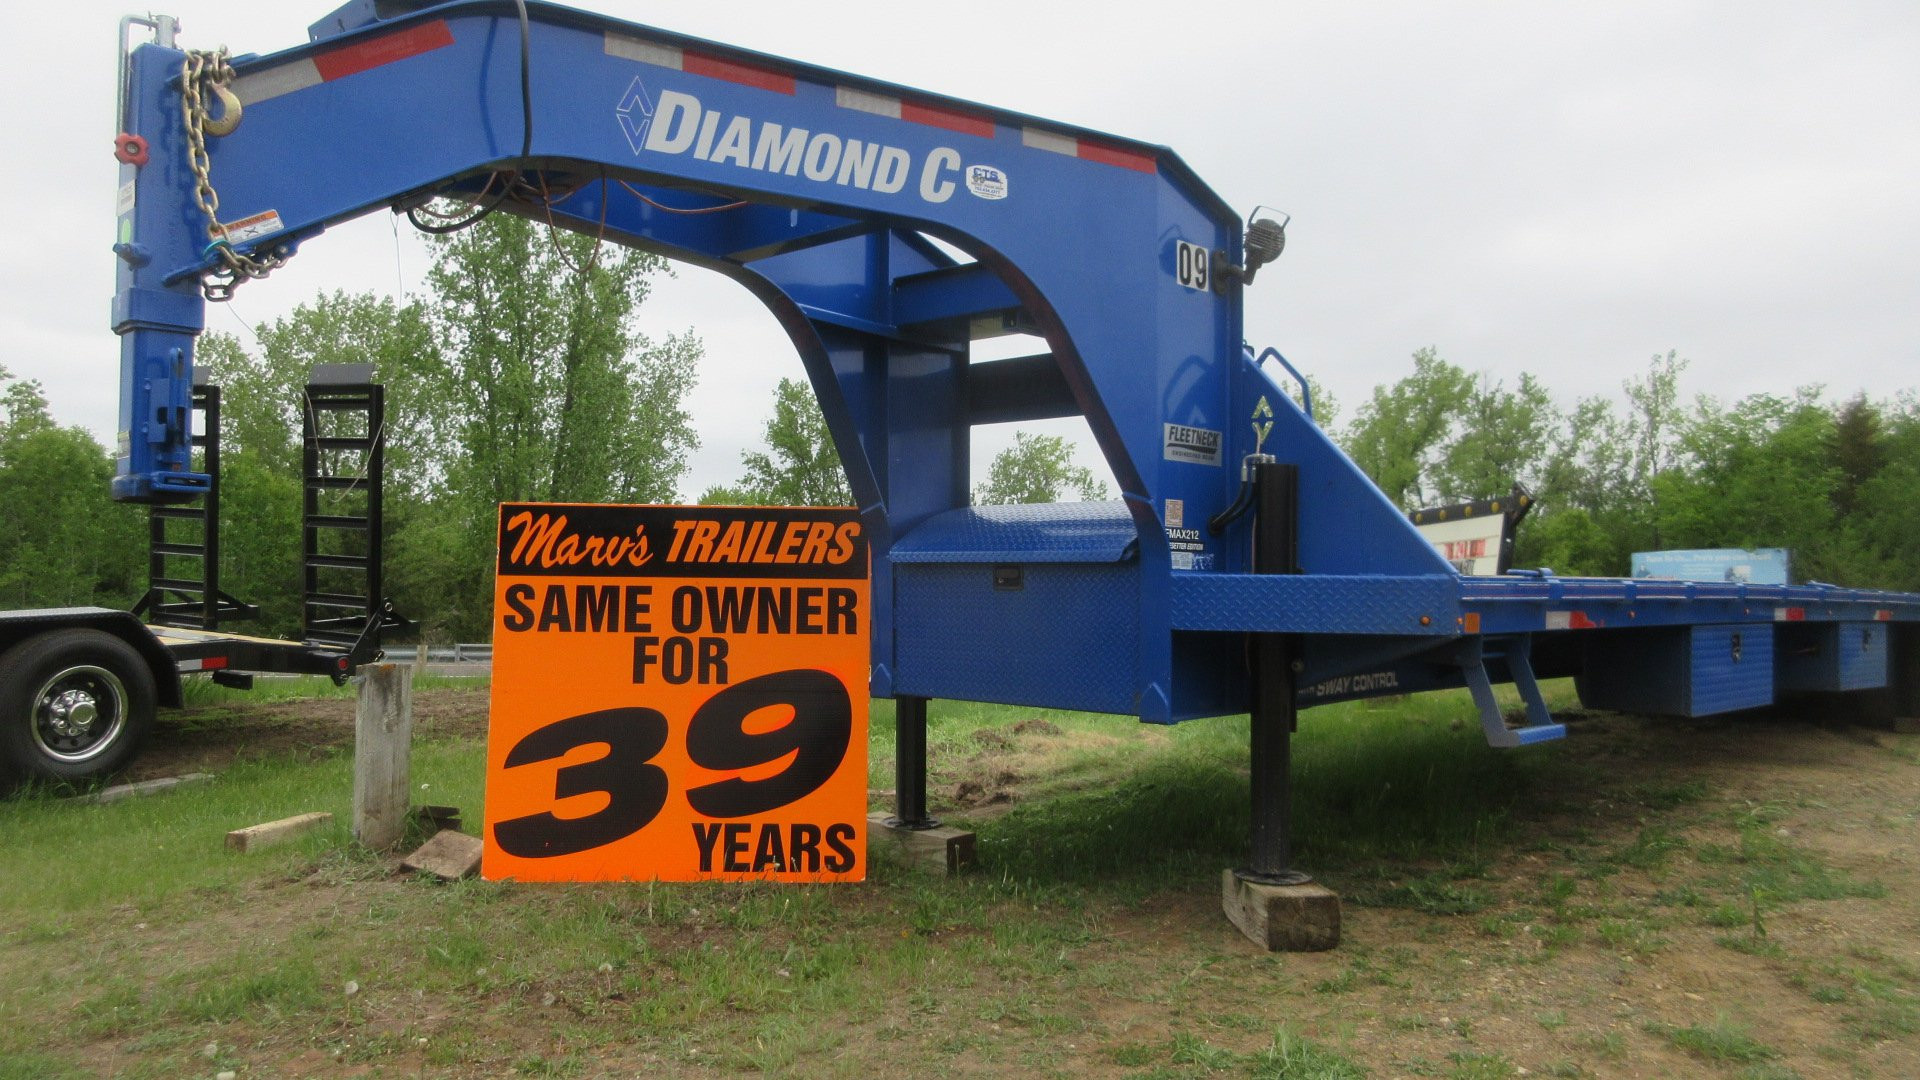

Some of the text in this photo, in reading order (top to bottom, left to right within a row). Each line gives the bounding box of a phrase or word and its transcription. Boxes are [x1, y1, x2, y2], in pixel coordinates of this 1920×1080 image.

[645, 89, 962, 203] DIAMOND C
[1179, 243, 1207, 290] 09
[1168, 425, 1220, 448] FLEETNECK
[507, 511, 861, 568] Marv's TRAILERS
[503, 584, 858, 635] SAME OWNER
[632, 636, 729, 685] FOR
[1317, 671, 1399, 697] SWAY CONTROL
[493, 669, 852, 859] 39
[692, 822, 857, 874] YEARS
